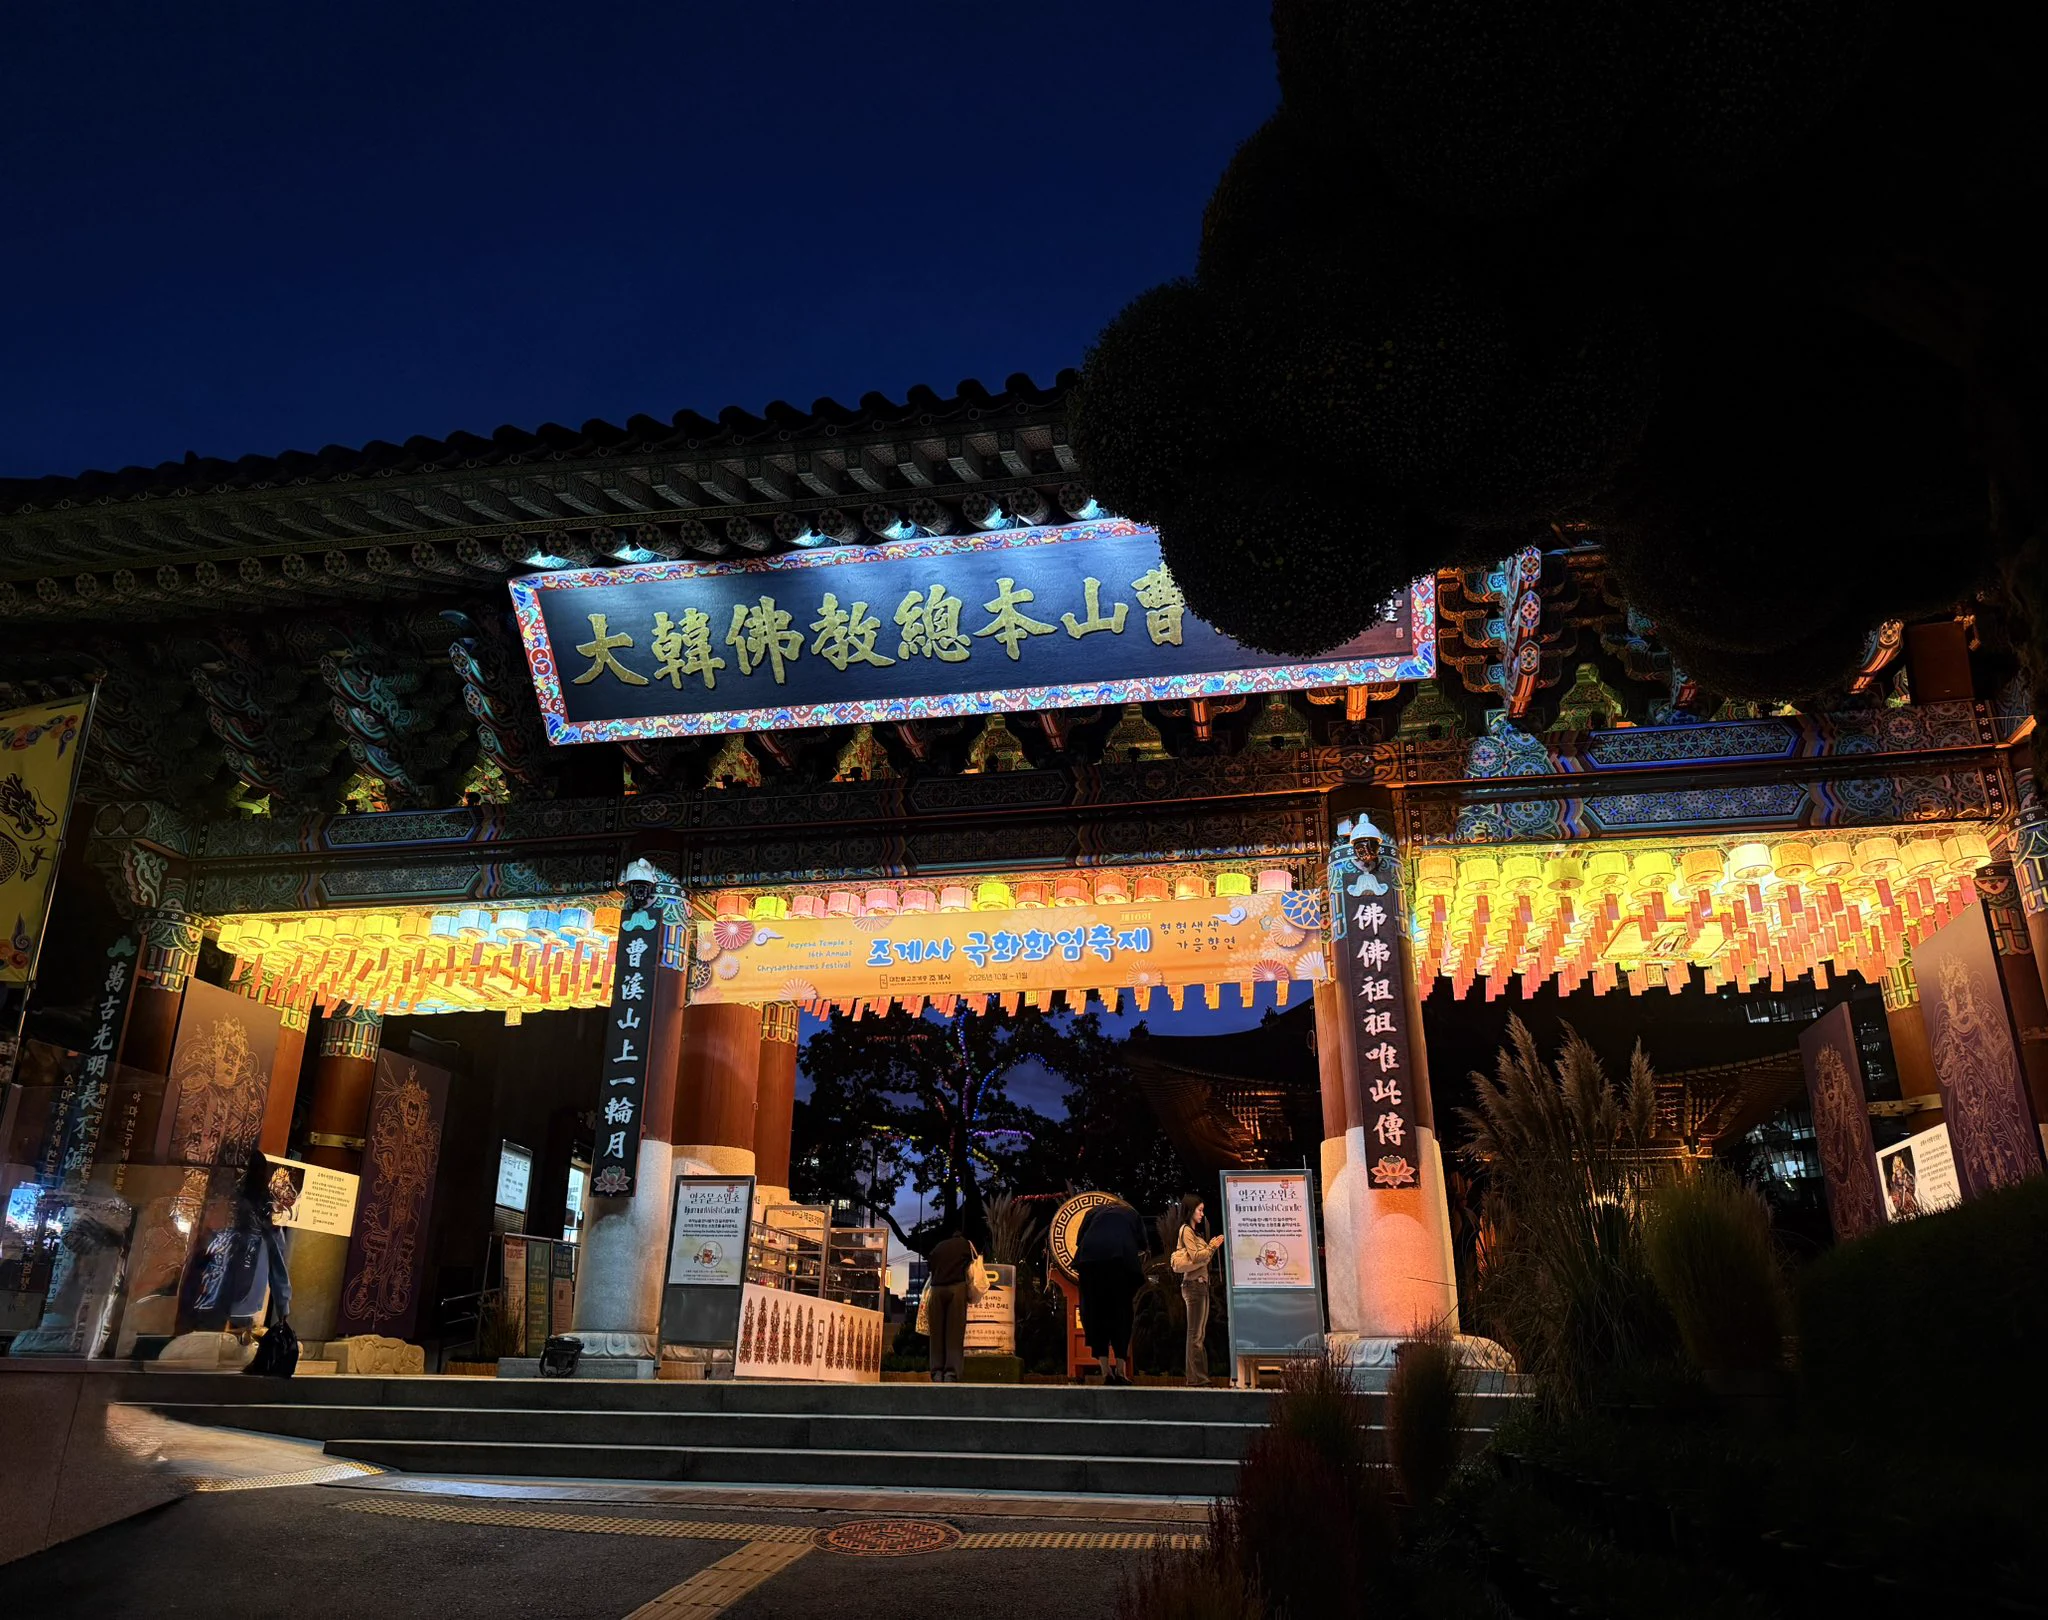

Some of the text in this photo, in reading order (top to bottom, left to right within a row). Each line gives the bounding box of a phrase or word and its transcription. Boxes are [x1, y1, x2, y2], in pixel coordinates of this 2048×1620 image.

[821, 960, 851, 969] Festival
[825, 949, 852, 957] Annual
[866, 937, 955, 967] 조계사
[1352, 903, 1406, 1147] 佛佛祖祖唯此傳
[603, 937, 649, 1160] 曹溪山上一輪月
